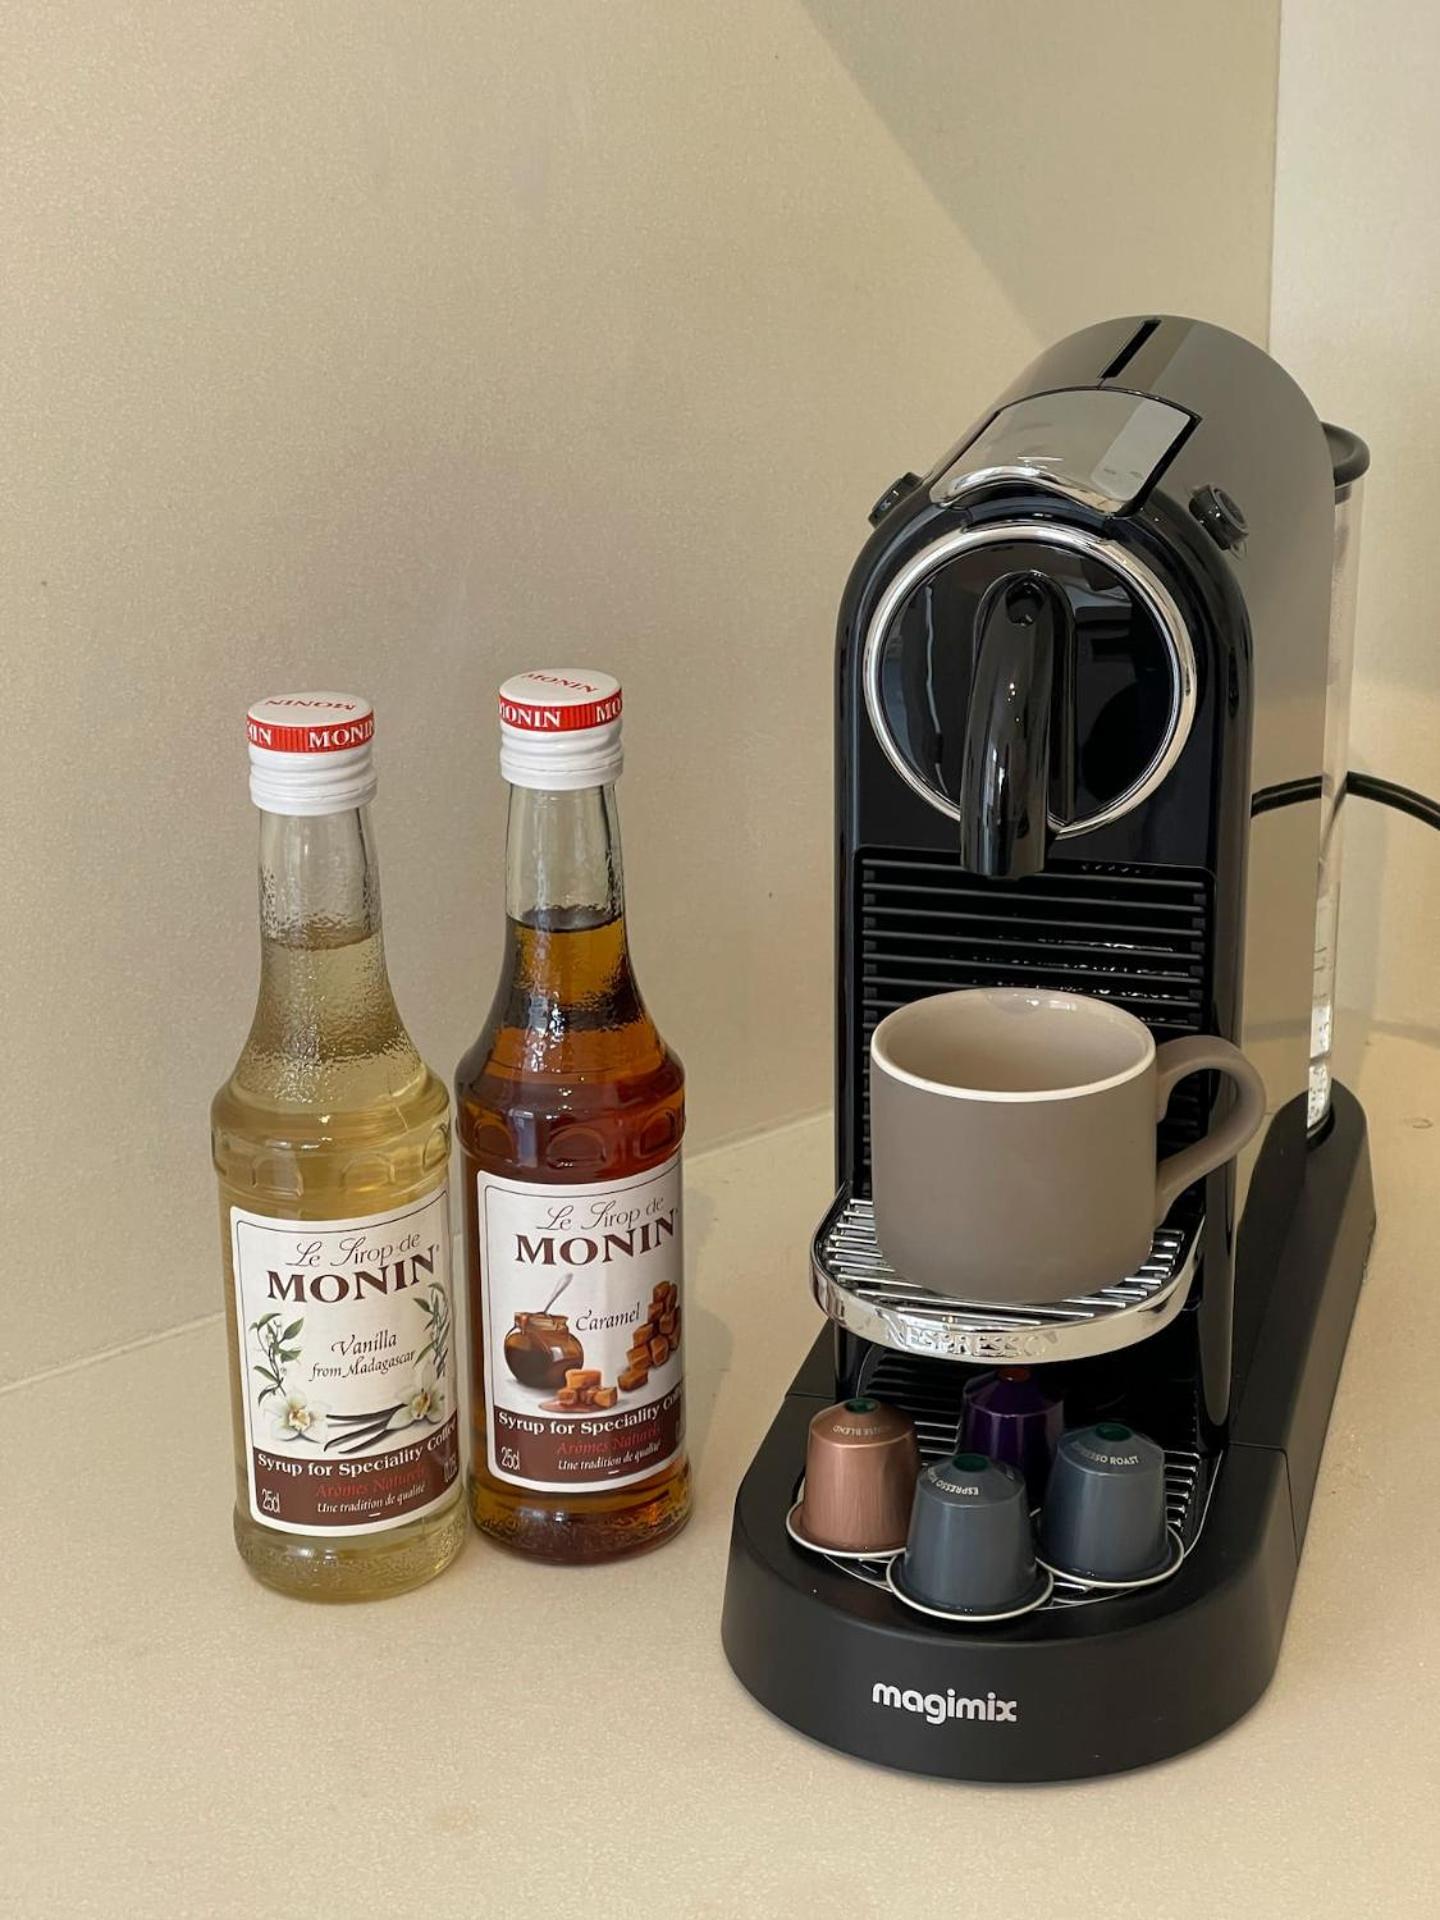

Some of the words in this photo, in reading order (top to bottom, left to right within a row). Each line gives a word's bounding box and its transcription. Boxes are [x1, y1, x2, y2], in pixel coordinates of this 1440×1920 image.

[520, 672, 599, 693] MONIN
[265, 699, 356, 710] MONIN
[536, 1205, 574, 1231] Le
[581, 1200, 641, 1230] Sirop
[646, 1197, 664, 1213] de
[285, 1241, 322, 1267] Le
[331, 1236, 393, 1267] Sirop
[399, 1233, 421, 1250] de
[515, 1208, 677, 1266] MONIN
[267, 1245, 438, 1303] MONIN
[576, 1303, 640, 1332] Caramel
[331, 1329, 399, 1357] Vanilla
[876, 1309, 1056, 1358] NESPRESSO
[308, 1364, 342, 1382] from
[343, 1350, 416, 1377] Madagascar
[499, 1412, 545, 1435] Syrup
[550, 1421, 575, 1434] for
[581, 1405, 660, 1436] Speciality
[257, 1453, 303, 1476] Syrup
[308, 1462, 333, 1476] for
[338, 1446, 423, 1478] Speciality
[501, 1446, 520, 1471] 25cl
[557, 1459, 578, 1471] Une
[580, 1456, 621, 1471] tradition
[623, 1450, 634, 1464] de
[1109, 1455, 1139, 1466] ROAST
[261, 1487, 281, 1514] 25cl
[936, 1479, 979, 1496] ESPRESSO
[317, 1502, 337, 1513] Une
[340, 1498, 382, 1513] tradition
[384, 1493, 396, 1506] de
[872, 1682, 1017, 1725] magimix
